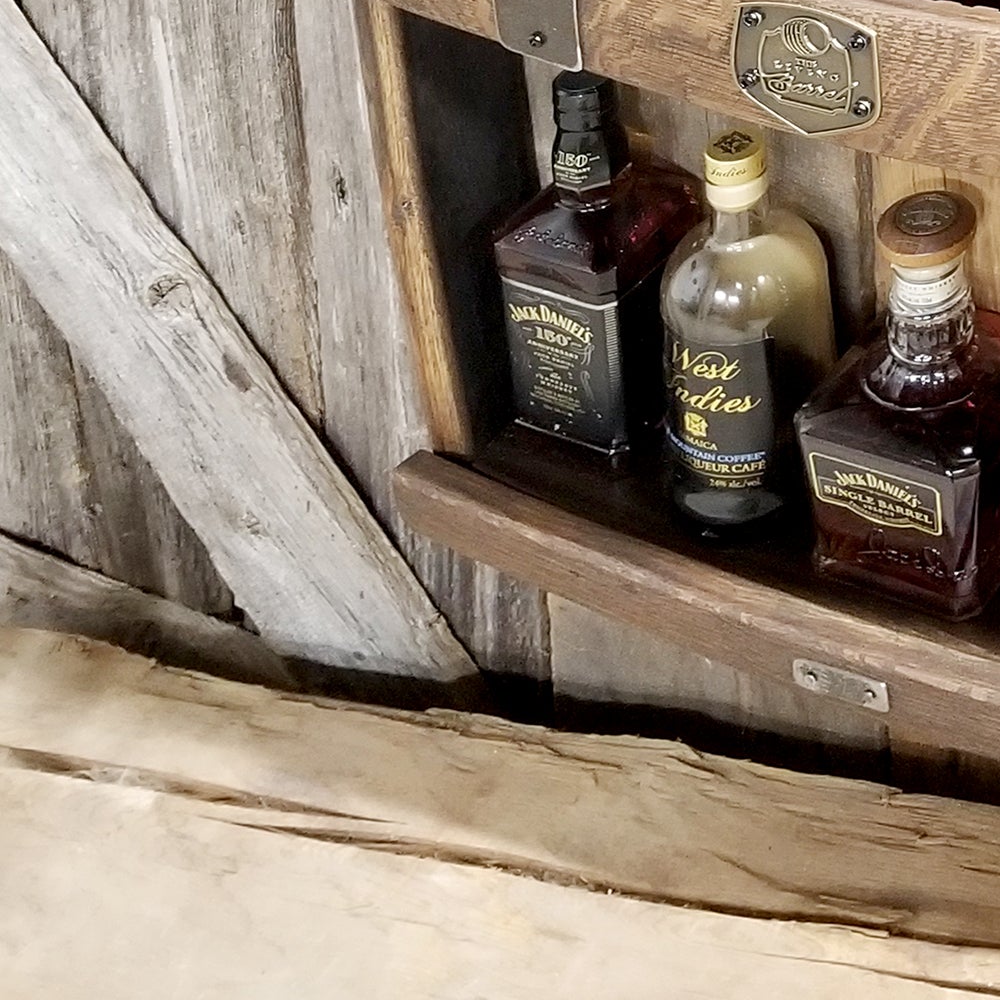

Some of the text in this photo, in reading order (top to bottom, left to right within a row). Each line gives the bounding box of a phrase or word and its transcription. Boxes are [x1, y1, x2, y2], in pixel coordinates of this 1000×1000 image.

[508, 303, 594, 343] JACK DANIEL'S
[672, 341, 741, 381] West
[731, 460, 766, 473] CAFÉ
[823, 485, 875, 505] SINGLE
[878, 500, 933, 524] BARREL
